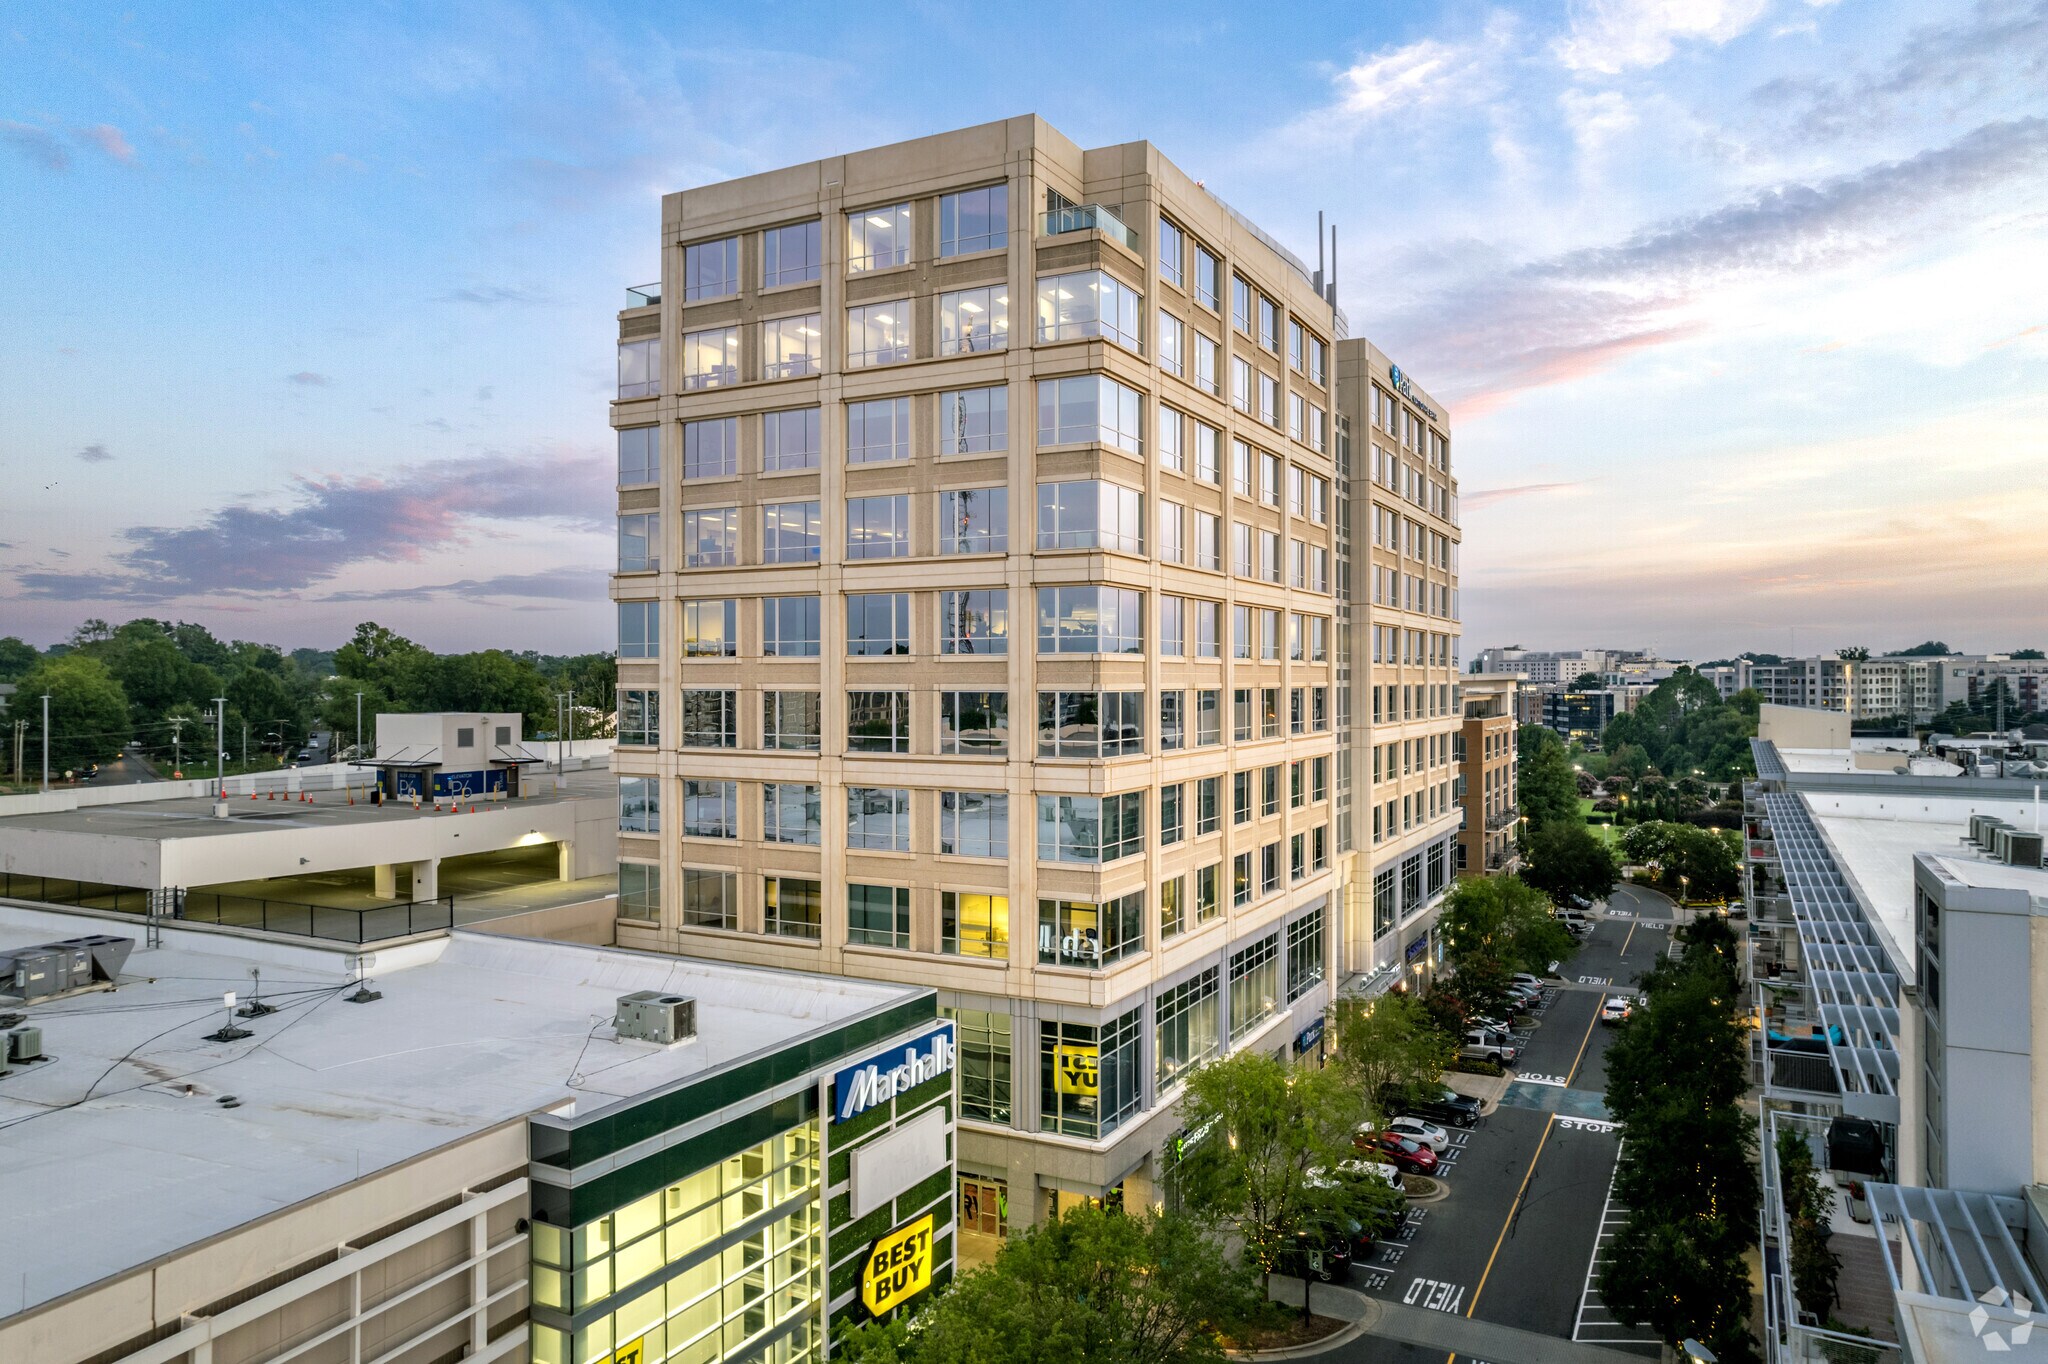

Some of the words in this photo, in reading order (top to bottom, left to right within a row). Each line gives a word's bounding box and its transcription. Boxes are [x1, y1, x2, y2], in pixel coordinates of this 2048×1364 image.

[452, 779, 472, 800] P6
[1641, 922, 1664, 930] YIELD
[1578, 975, 1607, 985] YIELD
[841, 1034, 955, 1118] Marshalls
[1518, 1072, 1566, 1084] STOP
[1560, 1120, 1614, 1133] STOP
[873, 1227, 929, 1279] BEST
[875, 1256, 925, 1305] BUY
[1403, 1277, 1465, 1314] YIELD
